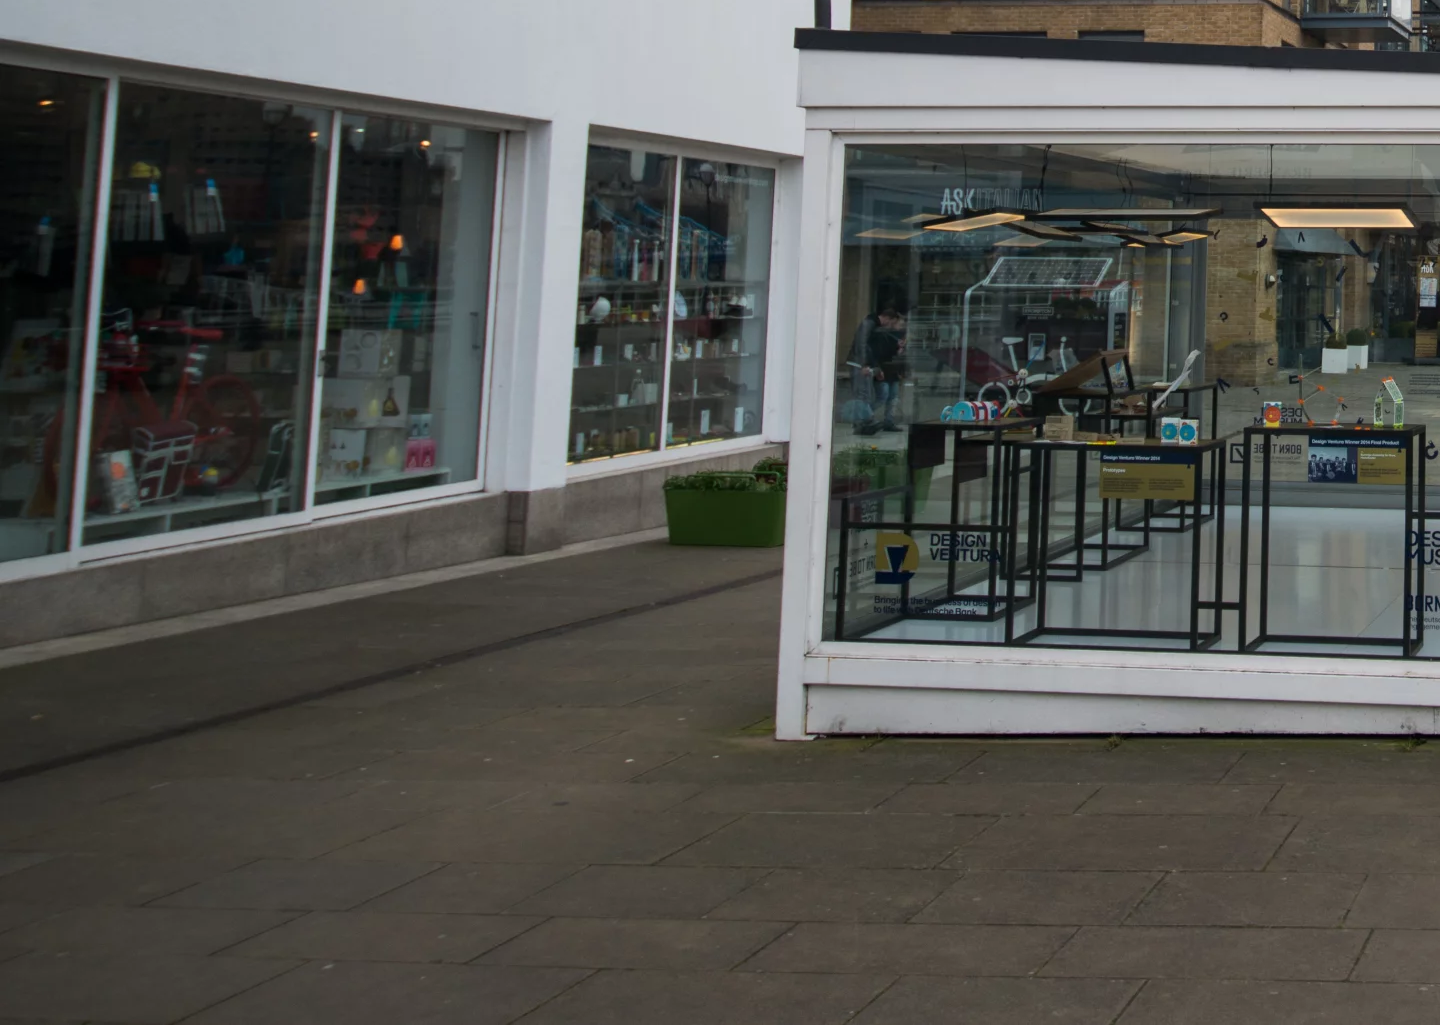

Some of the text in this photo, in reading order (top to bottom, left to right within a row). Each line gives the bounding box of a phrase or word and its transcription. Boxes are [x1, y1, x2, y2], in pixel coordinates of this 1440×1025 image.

[940, 187, 975, 215] ASK
[929, 533, 987, 548] DESIGN
[929, 547, 1001, 562] VENTURA
